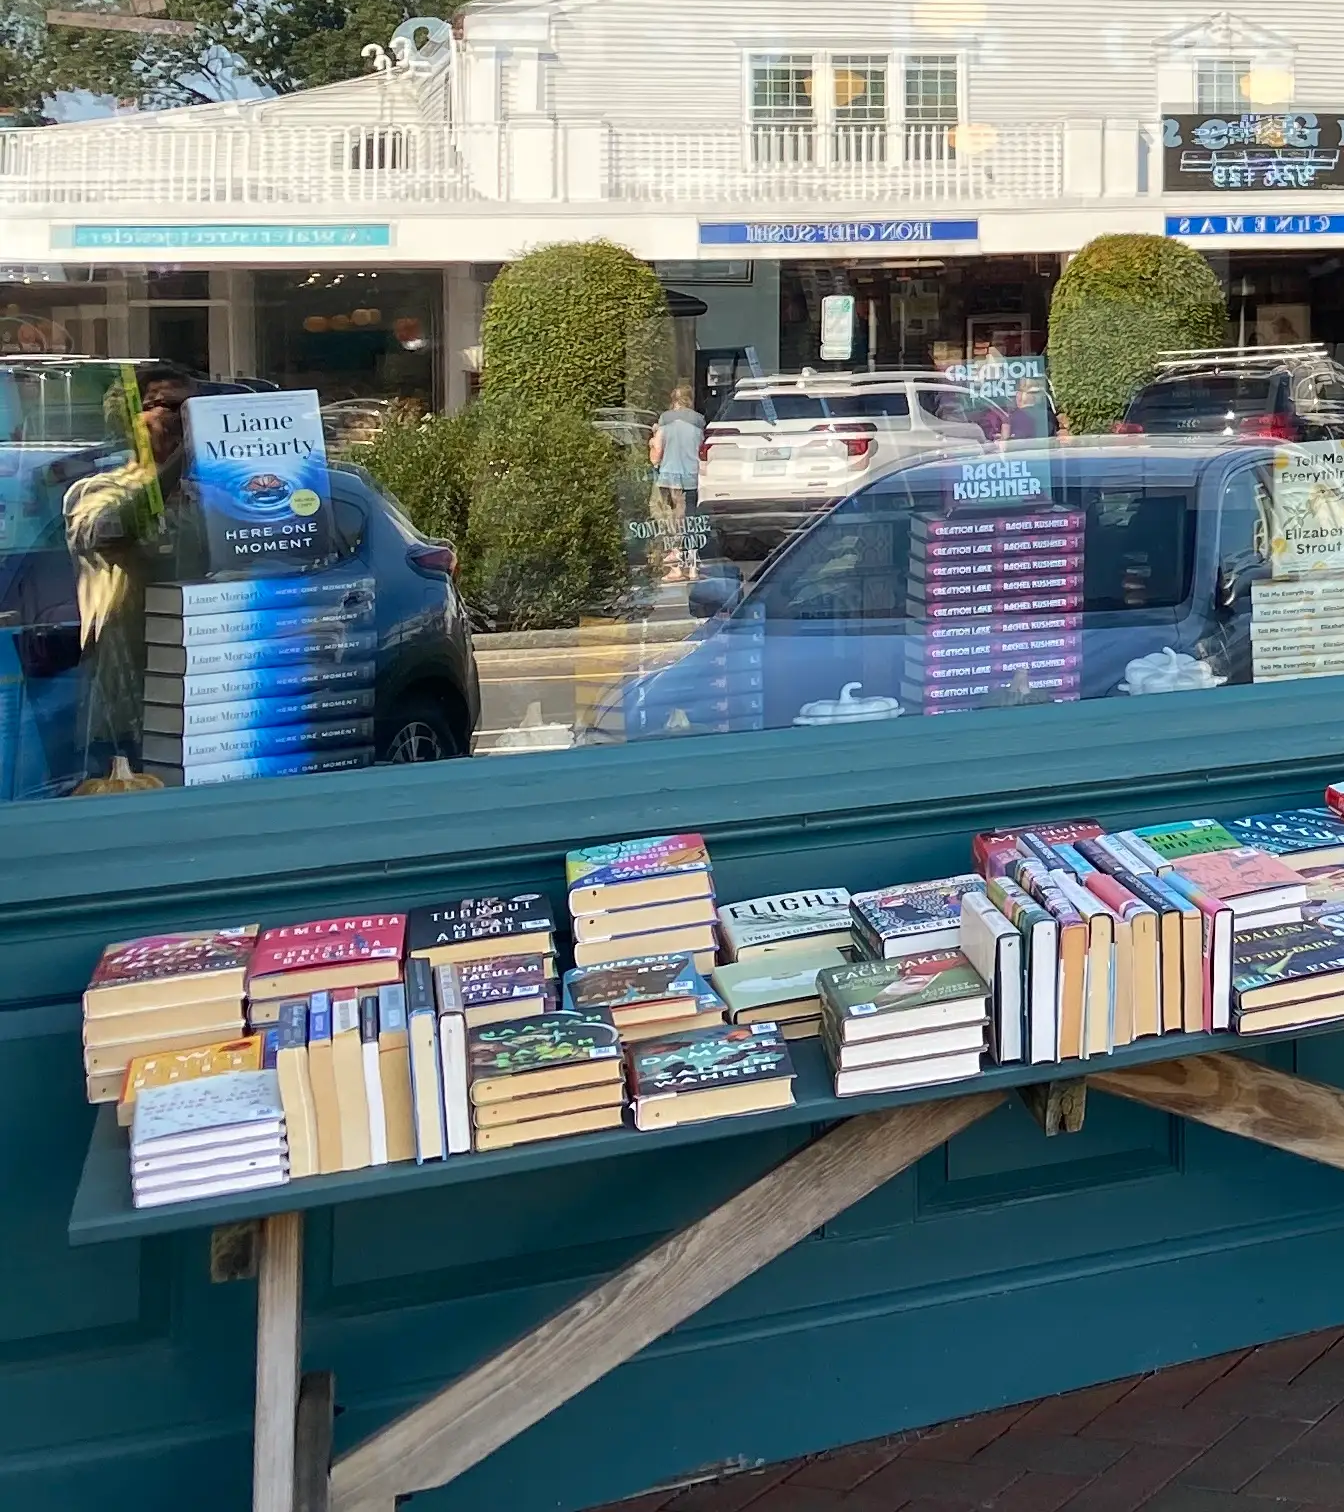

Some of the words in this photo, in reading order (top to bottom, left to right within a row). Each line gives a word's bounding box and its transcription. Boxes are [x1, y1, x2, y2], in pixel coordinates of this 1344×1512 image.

[945, 361, 1042, 381] CREATION
[970, 380, 1017, 398] LAKE
[222, 412, 294, 433] Liane
[206, 437, 315, 460] Moriarty
[962, 460, 1032, 481] RACHEL
[1295, 454, 1318, 467] Tell
[1322, 453, 1344, 464] Me
[953, 478, 1041, 500] KUSHNER
[225, 526, 273, 540] HERE
[282, 522, 318, 535] ONE
[629, 514, 711, 540] SOMEWHERE
[235, 538, 313, 554] MOMENT
[664, 534, 707, 551] BEYOND
[1296, 541, 1342, 555] Strout
[1234, 819, 1335, 841] VIRTU
[430, 901, 532, 922] TURNOUT
[729, 894, 840, 919] FLIGHT
[265, 917, 399, 941] FEMLANDIA
[1291, 938, 1339, 954] DARK
[638, 962, 680, 974] ROY
[654, 1064, 776, 1088] WAHRER
